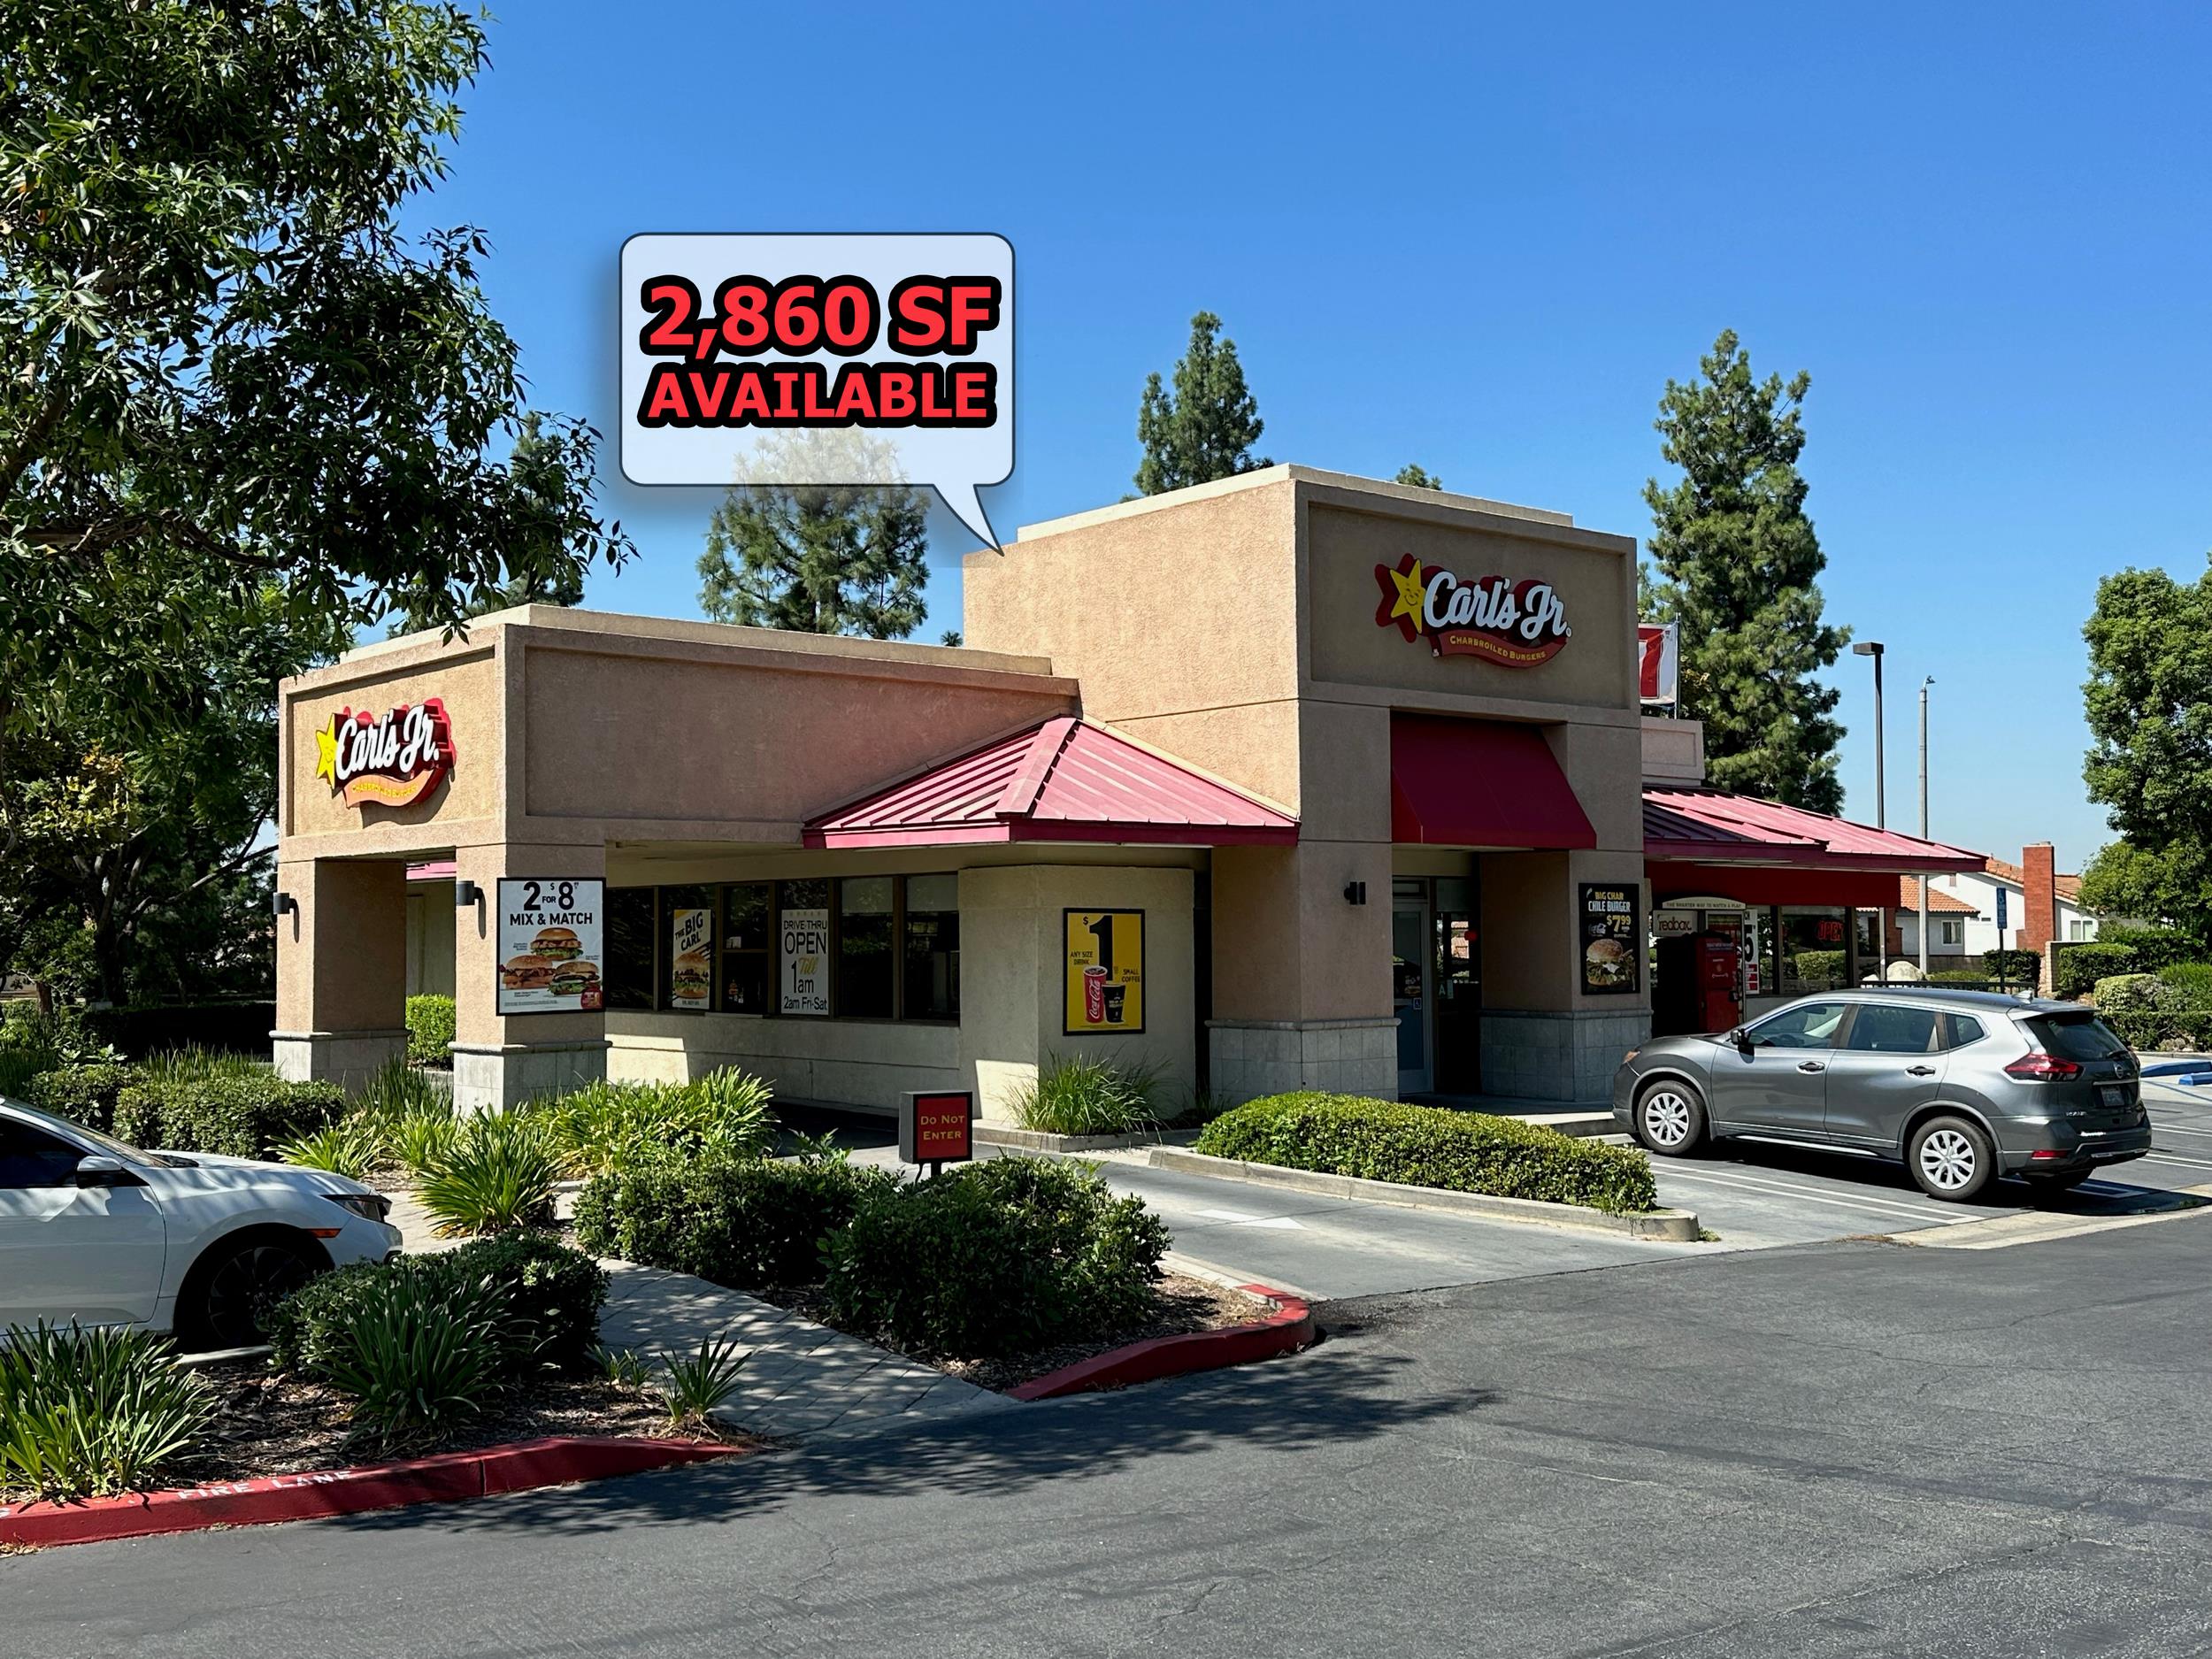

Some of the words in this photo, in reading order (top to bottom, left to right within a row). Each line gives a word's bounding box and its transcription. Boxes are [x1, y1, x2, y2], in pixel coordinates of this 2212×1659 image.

[1424, 571, 1521, 630] Carl's
[1520, 585, 1572, 640] Jr.
[336, 709, 401, 780] Carl's
[399, 705, 440, 773] Jr.
[523, 881, 541, 911] 2
[510, 914, 534, 926] MIX
[537, 913, 546, 926] &
[549, 912, 593, 925] MATCH
[675, 927, 685, 940] THE
[685, 911, 703, 936] BIG
[680, 932, 702, 951] CARL
[784, 932, 826, 955] OPEN
[783, 996, 800, 1010] 2am
[802, 996, 827, 1010] Fri-Sat
[178, 1482, 255, 1500] FIRE
[271, 1471, 352, 1489] LANE
